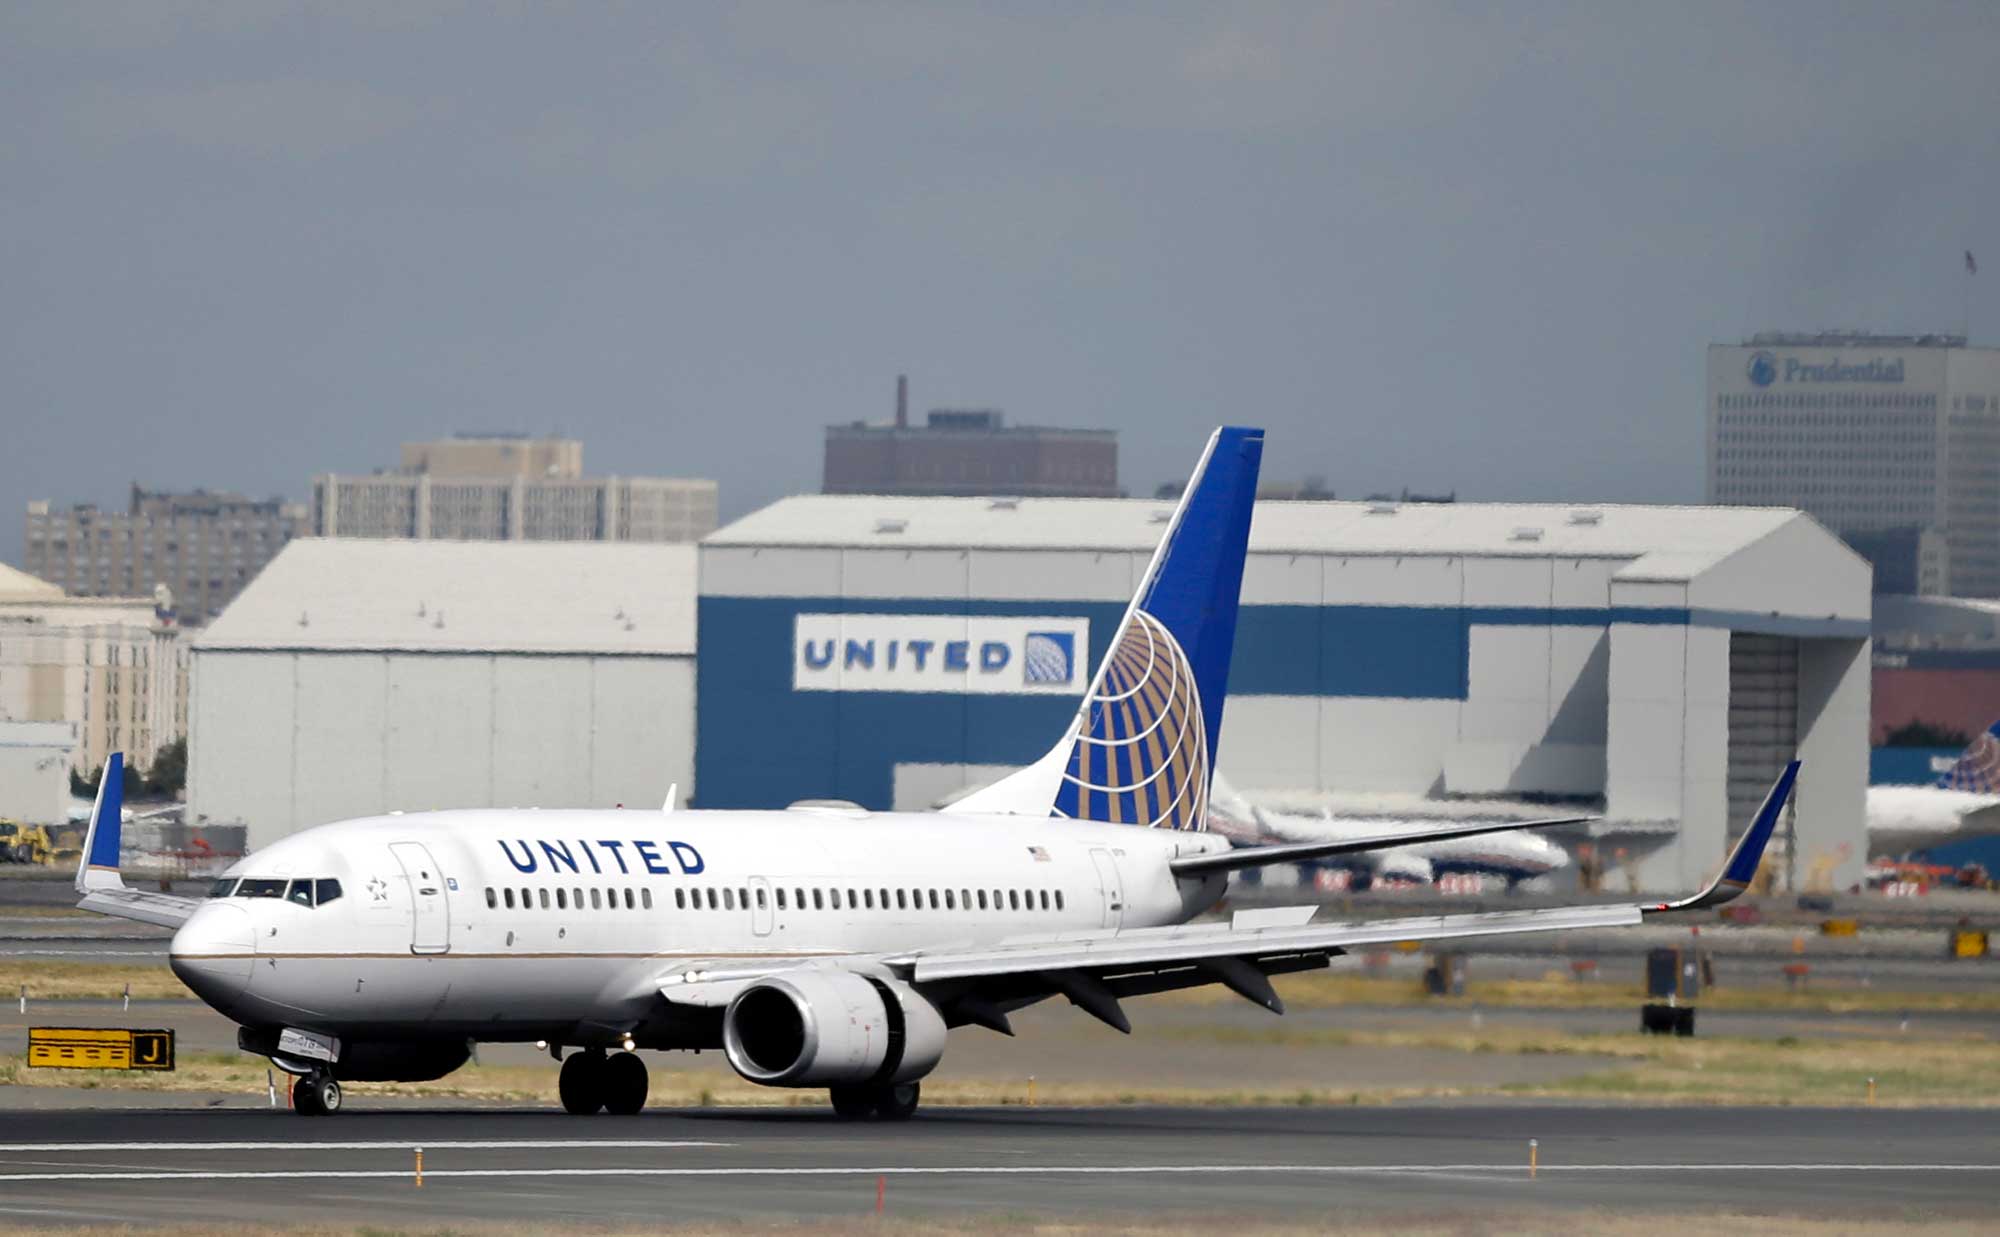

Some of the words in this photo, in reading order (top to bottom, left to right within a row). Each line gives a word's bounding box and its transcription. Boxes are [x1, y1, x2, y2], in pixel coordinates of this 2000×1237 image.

[1784, 357, 1904, 383] Prudential
[804, 639, 1012, 673] UNITED
[497, 839, 705, 875] UNITED
[143, 1038, 159, 1062] J
